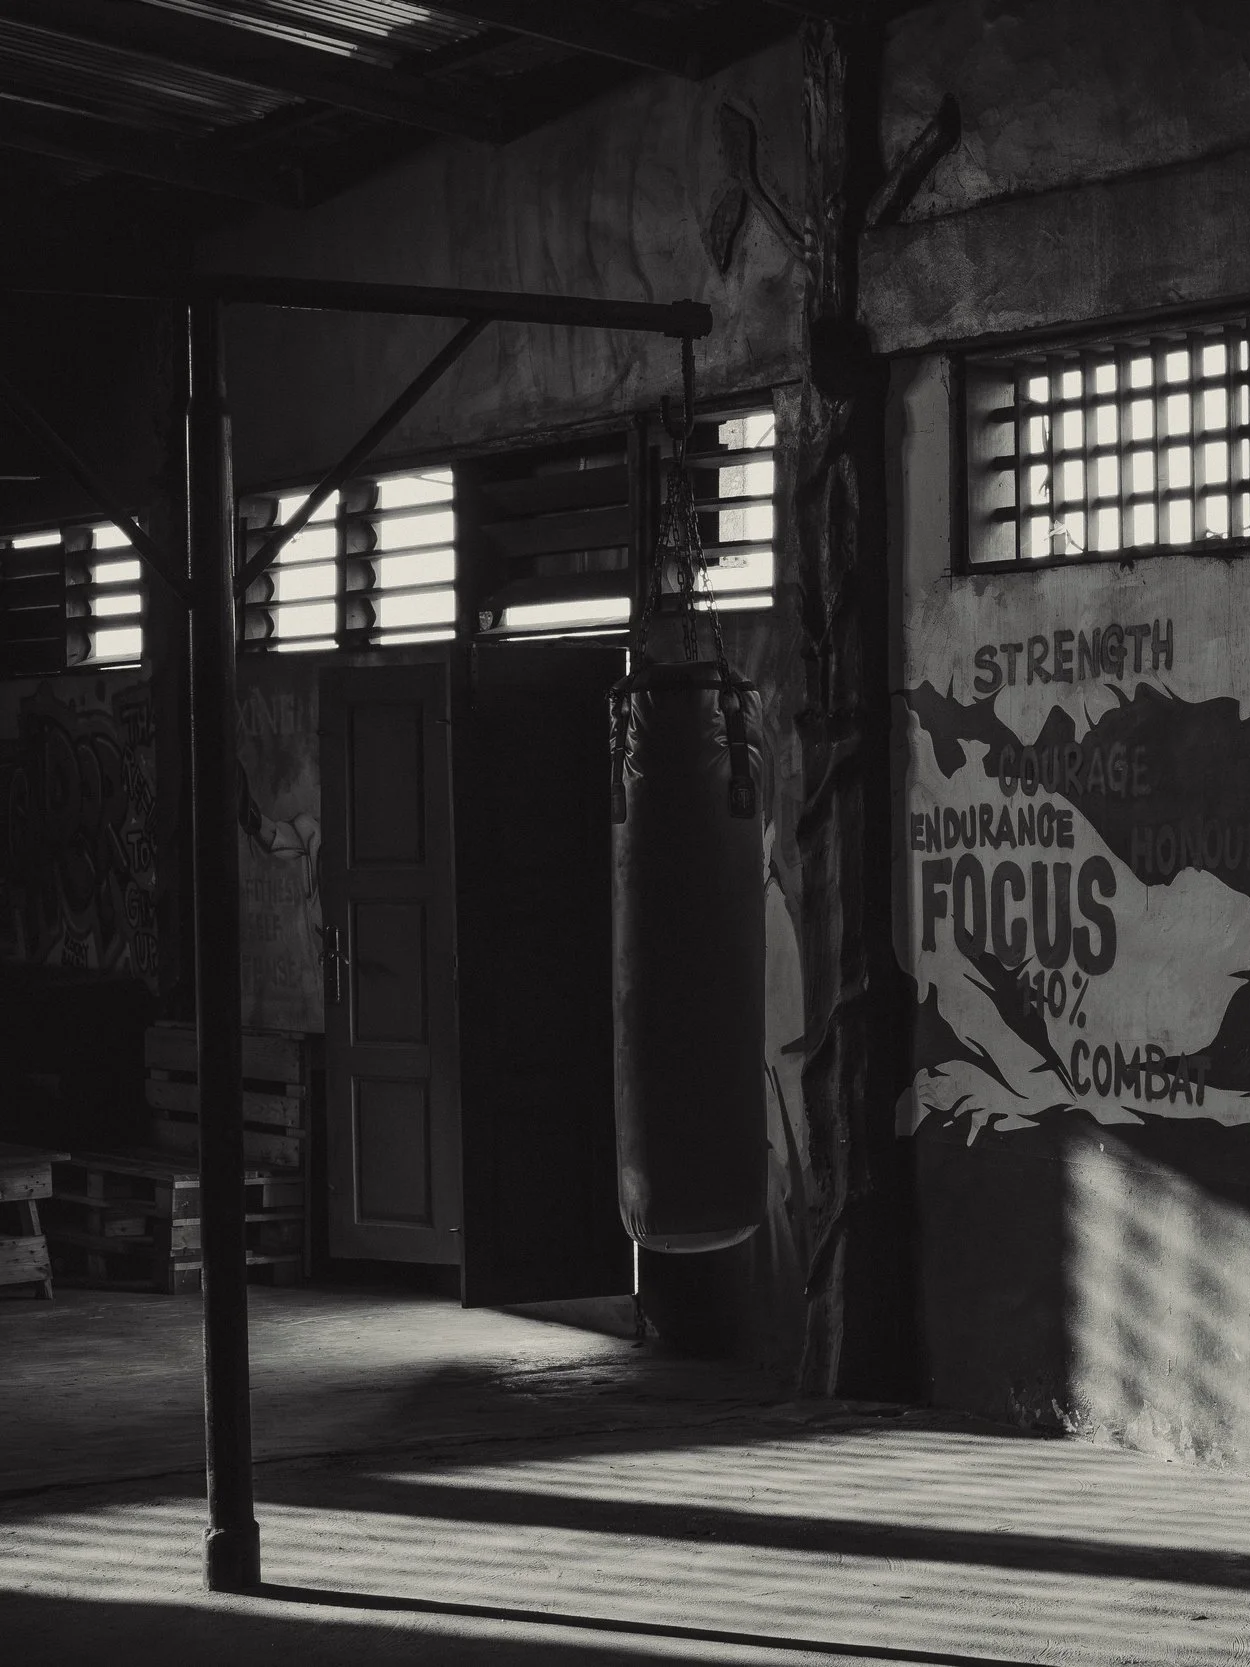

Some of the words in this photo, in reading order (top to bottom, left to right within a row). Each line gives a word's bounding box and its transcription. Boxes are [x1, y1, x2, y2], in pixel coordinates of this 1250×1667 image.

[973, 618, 1174, 694] STRENGTH
[999, 740, 1152, 799] COURAGE
[921, 852, 1118, 976] FOCUS
[1016, 969, 1090, 1029] 110%
[1070, 1038, 1212, 1107] COMBAT
